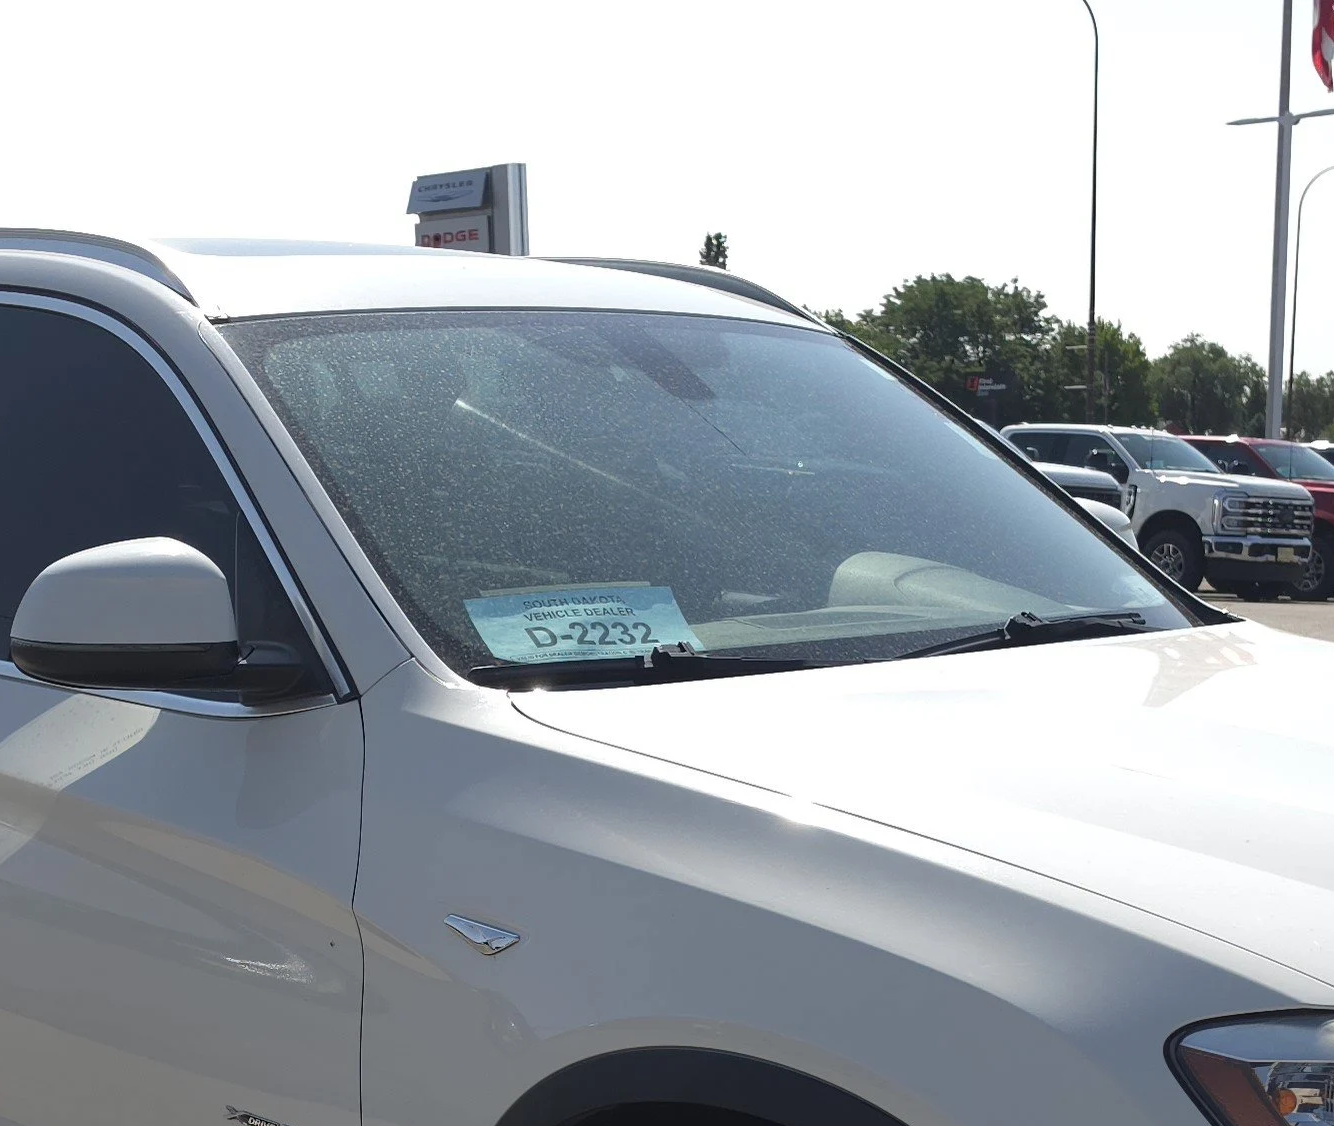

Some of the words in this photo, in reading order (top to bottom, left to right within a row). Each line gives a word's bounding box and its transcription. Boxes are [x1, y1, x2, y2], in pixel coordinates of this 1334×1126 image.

[417, 179, 474, 193] CHRYSLER
[421, 228, 480, 248] DODGE
[522, 597, 569, 610] SOUTH
[570, 594, 627, 606] DAKOTA
[524, 608, 581, 623] VEHICLE
[585, 606, 636, 618] DEALER
[524, 621, 660, 649] D-2232
